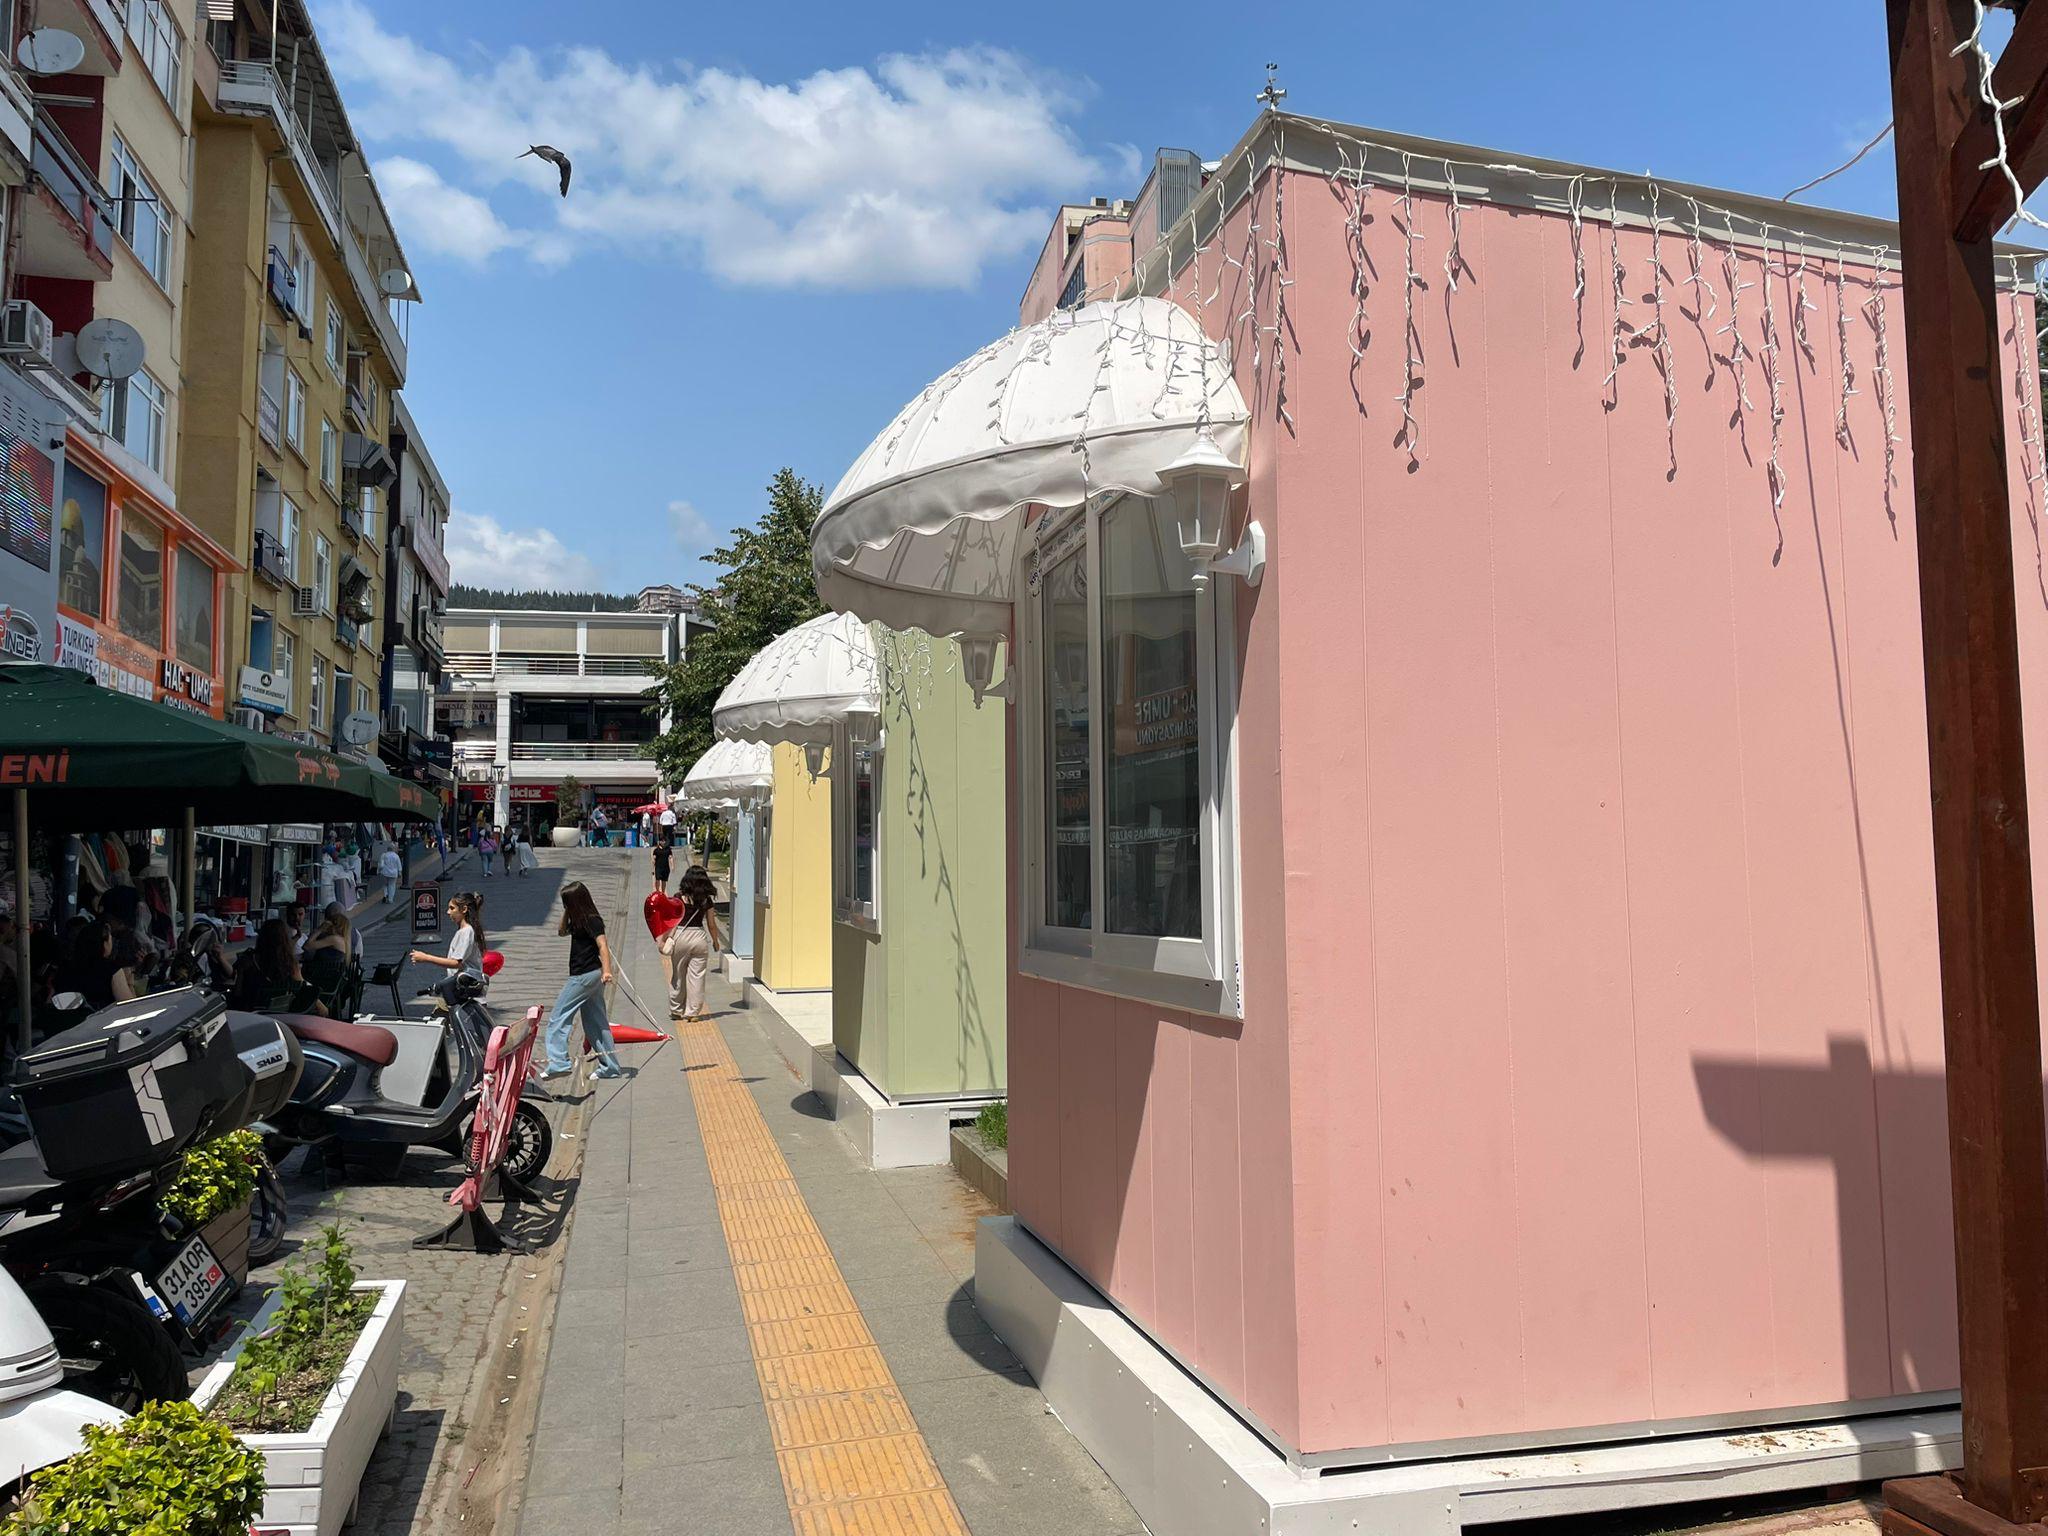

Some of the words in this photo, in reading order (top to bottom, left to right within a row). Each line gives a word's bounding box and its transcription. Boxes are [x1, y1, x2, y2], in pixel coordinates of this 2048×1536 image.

[63, 625, 95, 656] TURKISH
[61, 648, 94, 676] AIRLINES
[256, 1054, 283, 1069] SHAD
[185, 1272, 212, 1309] 395
